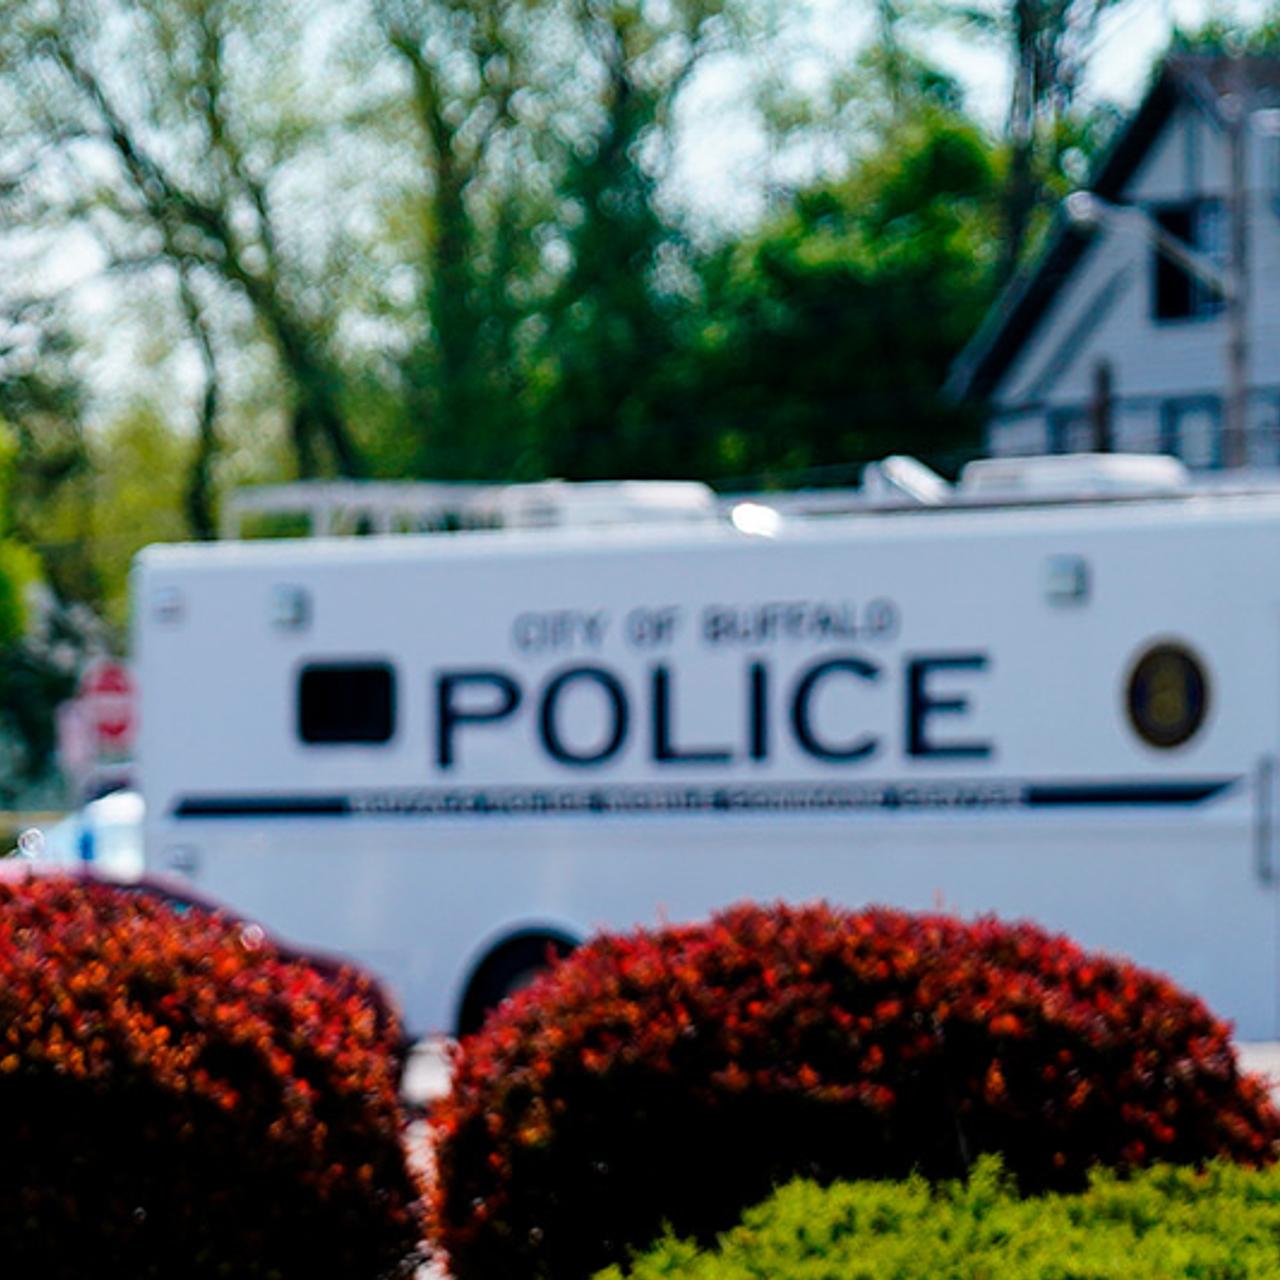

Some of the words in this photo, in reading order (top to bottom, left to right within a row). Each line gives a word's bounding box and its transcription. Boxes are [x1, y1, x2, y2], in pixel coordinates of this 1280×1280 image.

[513, 609, 605, 652] CITY
[626, 605, 679, 648] OF
[701, 597, 900, 645] BUFFALO
[433, 652, 995, 771] POLICE
